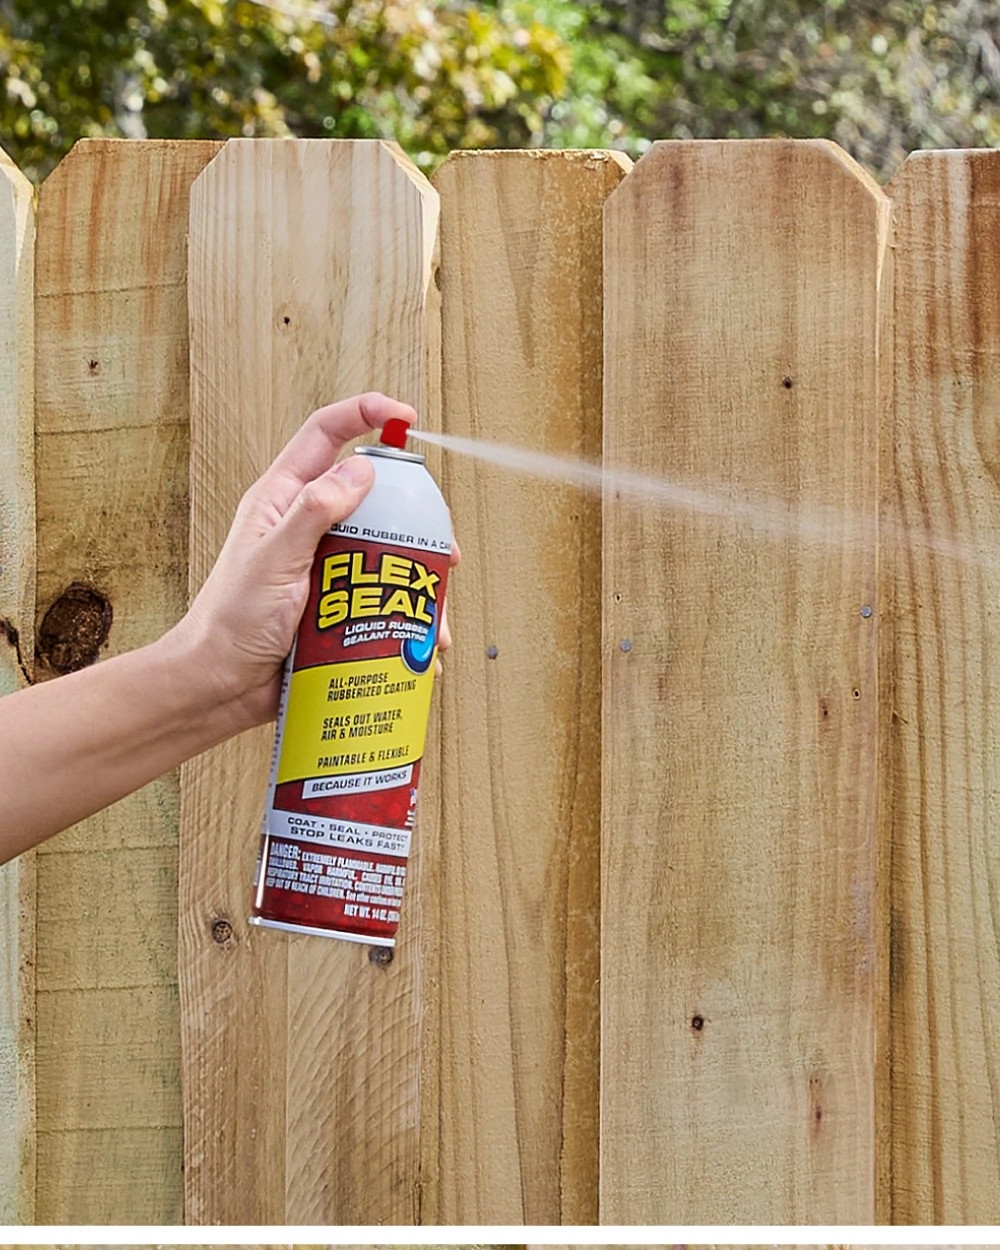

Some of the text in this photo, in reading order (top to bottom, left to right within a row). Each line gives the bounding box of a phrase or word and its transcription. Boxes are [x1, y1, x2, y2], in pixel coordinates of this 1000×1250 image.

[330, 523, 452, 550] QUID RUBBER IN A CA
[321, 551, 441, 600] FLEX
[317, 586, 433, 630] SEAL
[343, 630, 426, 647] SEALANT COATING
[344, 620, 428, 636] LIQUID RUBBER
[326, 679, 417, 702] RUBBERIZED COATING
[328, 672, 389, 690] ALL-PURPOSE
[321, 722, 394, 742] AIR & MOISTURE
[322, 715, 351, 730] SEALS
[353, 713, 371, 726] OUT
[317, 745, 410, 769] PAINTABLE & FLEXIBLE
[312, 770, 408, 793] BECAUSE IT WORKS
[288, 816, 408, 842] COAT SEAL PROTECT
[290, 826, 325, 838] STOP
[329, 832, 373, 847] LEAKS
